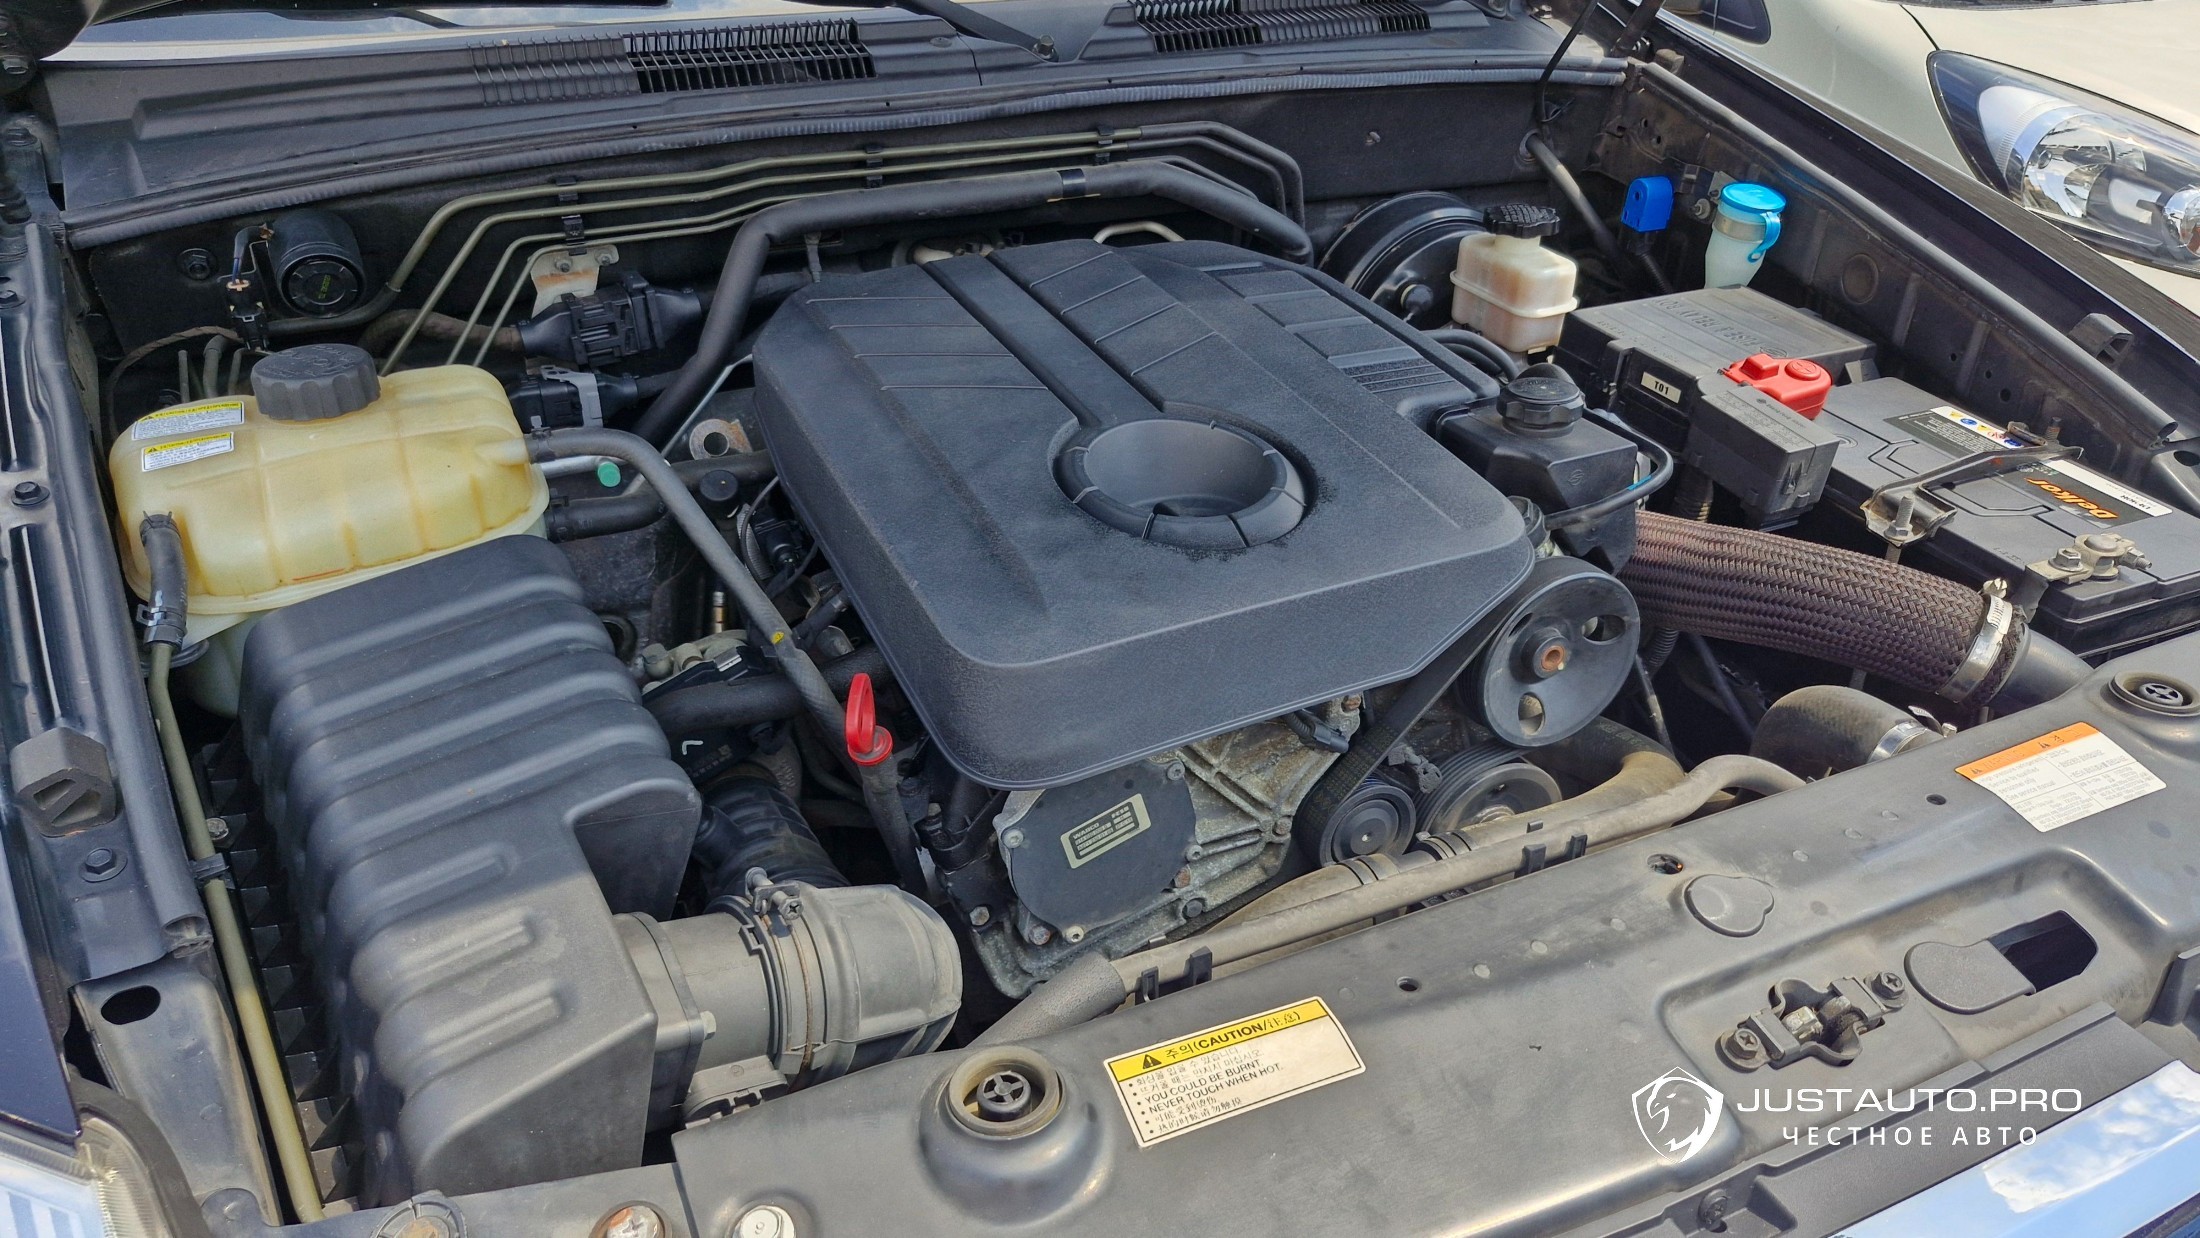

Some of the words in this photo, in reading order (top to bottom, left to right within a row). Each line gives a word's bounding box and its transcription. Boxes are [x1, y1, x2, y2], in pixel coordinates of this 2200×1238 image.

[1654, 380, 1669, 395] T01
[2024, 477, 2119, 519] Delkor
[1144, 1091, 1168, 1104] YOU
[1169, 1077, 1208, 1096] COULD
[1208, 1071, 1224, 1082] BE
[1224, 1058, 1263, 1077] BURNT.
[1148, 1095, 1185, 1114] NEVER
[1185, 1082, 1224, 1101] TOUCH
[1224, 1070, 1258, 1087] WHEN
[1257, 1061, 1283, 1076] HOT.
